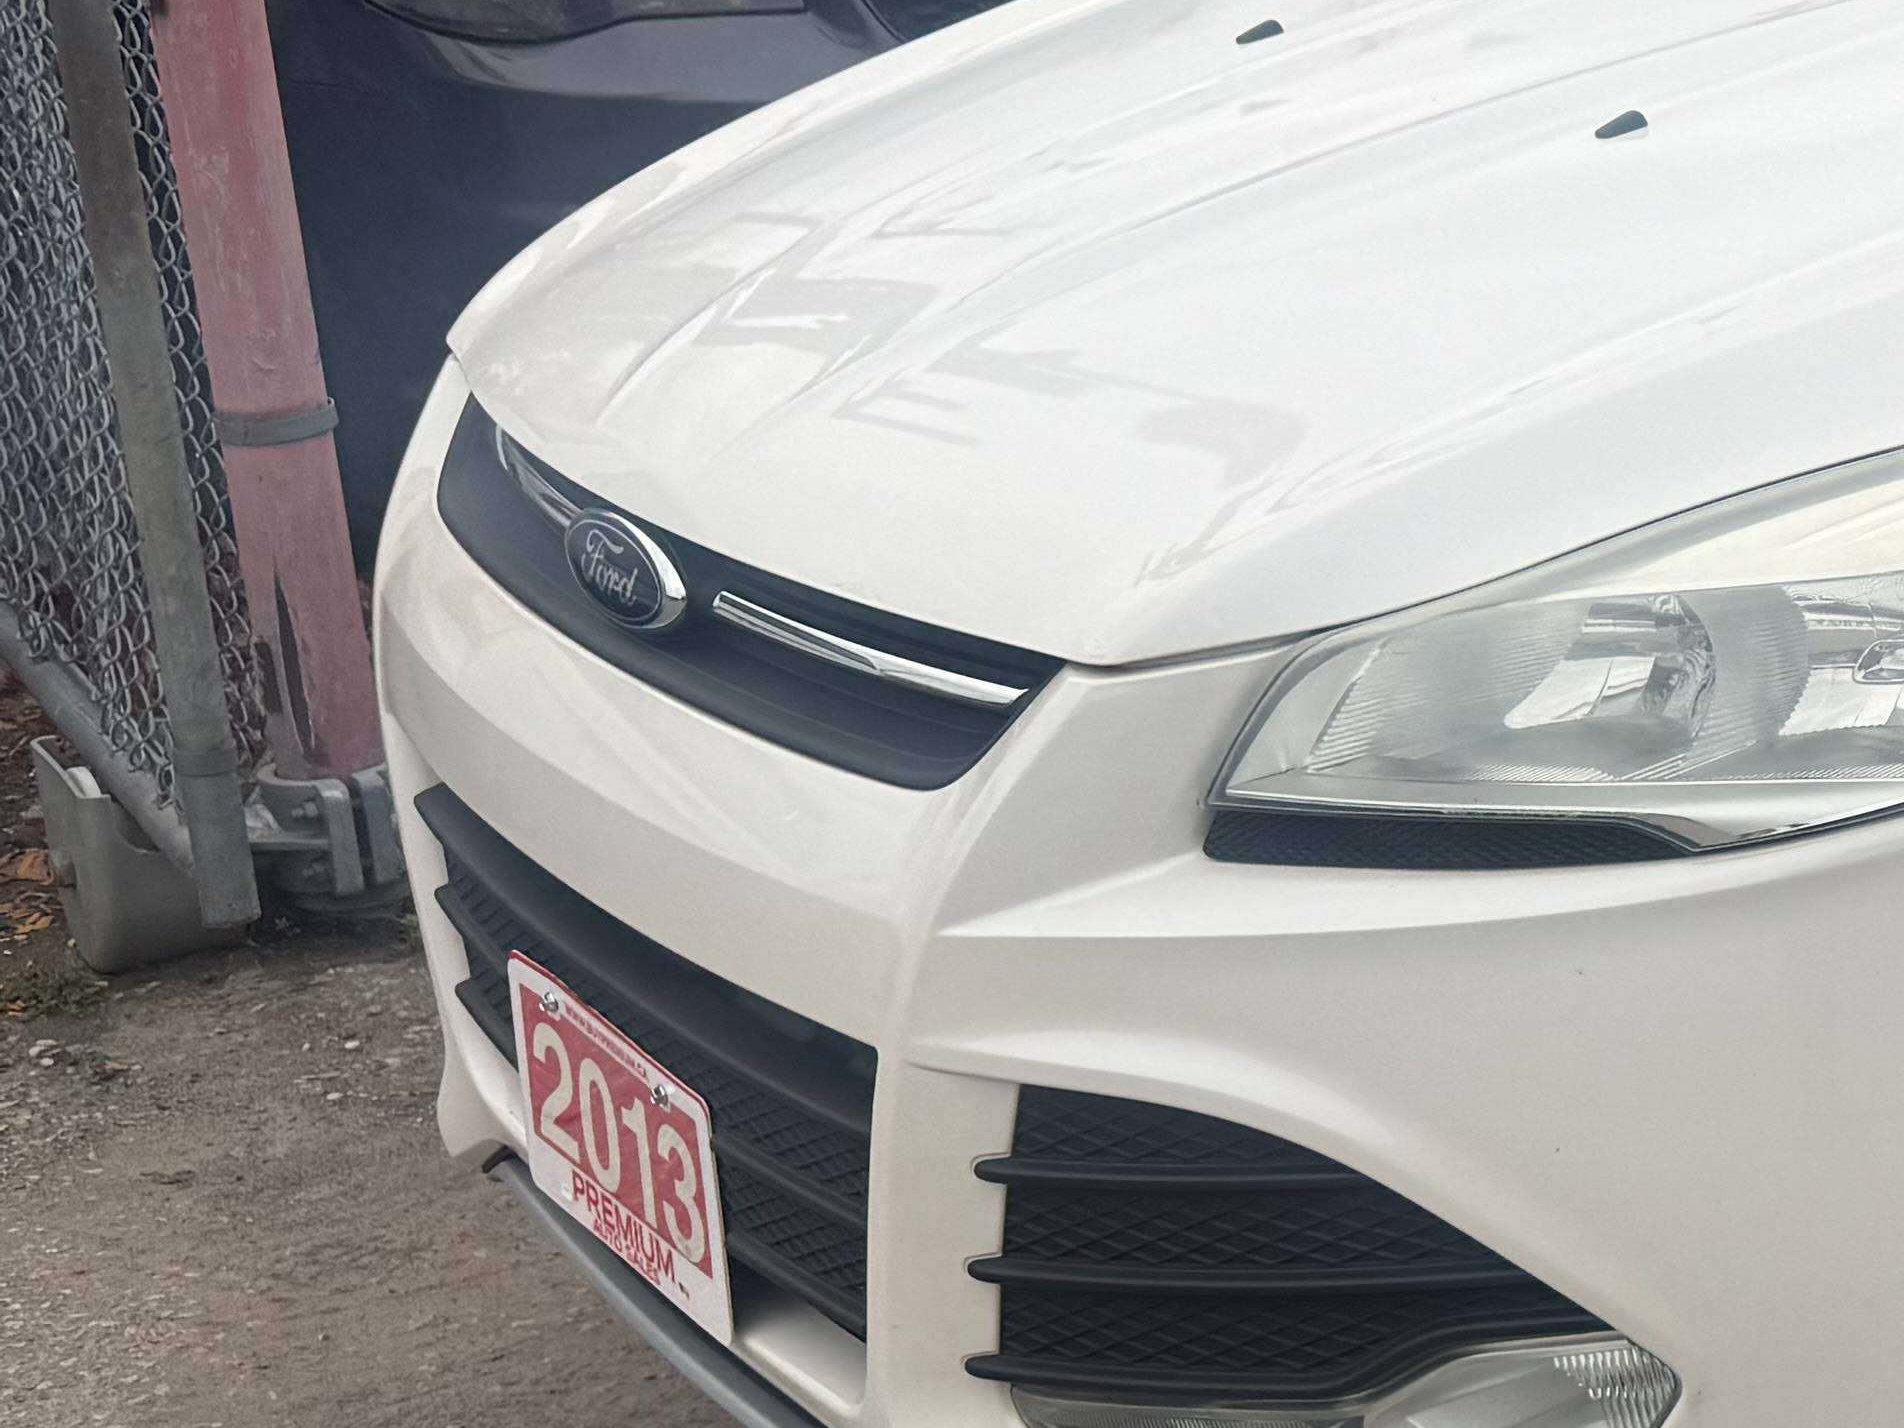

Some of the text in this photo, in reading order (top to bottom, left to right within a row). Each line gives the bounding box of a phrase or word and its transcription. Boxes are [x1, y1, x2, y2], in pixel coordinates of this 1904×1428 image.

[580, 529, 638, 606] Ford
[533, 1021, 705, 1264] 2013
[571, 1169, 676, 1284] PREMIUM
[593, 1218, 622, 1253] AUTO
